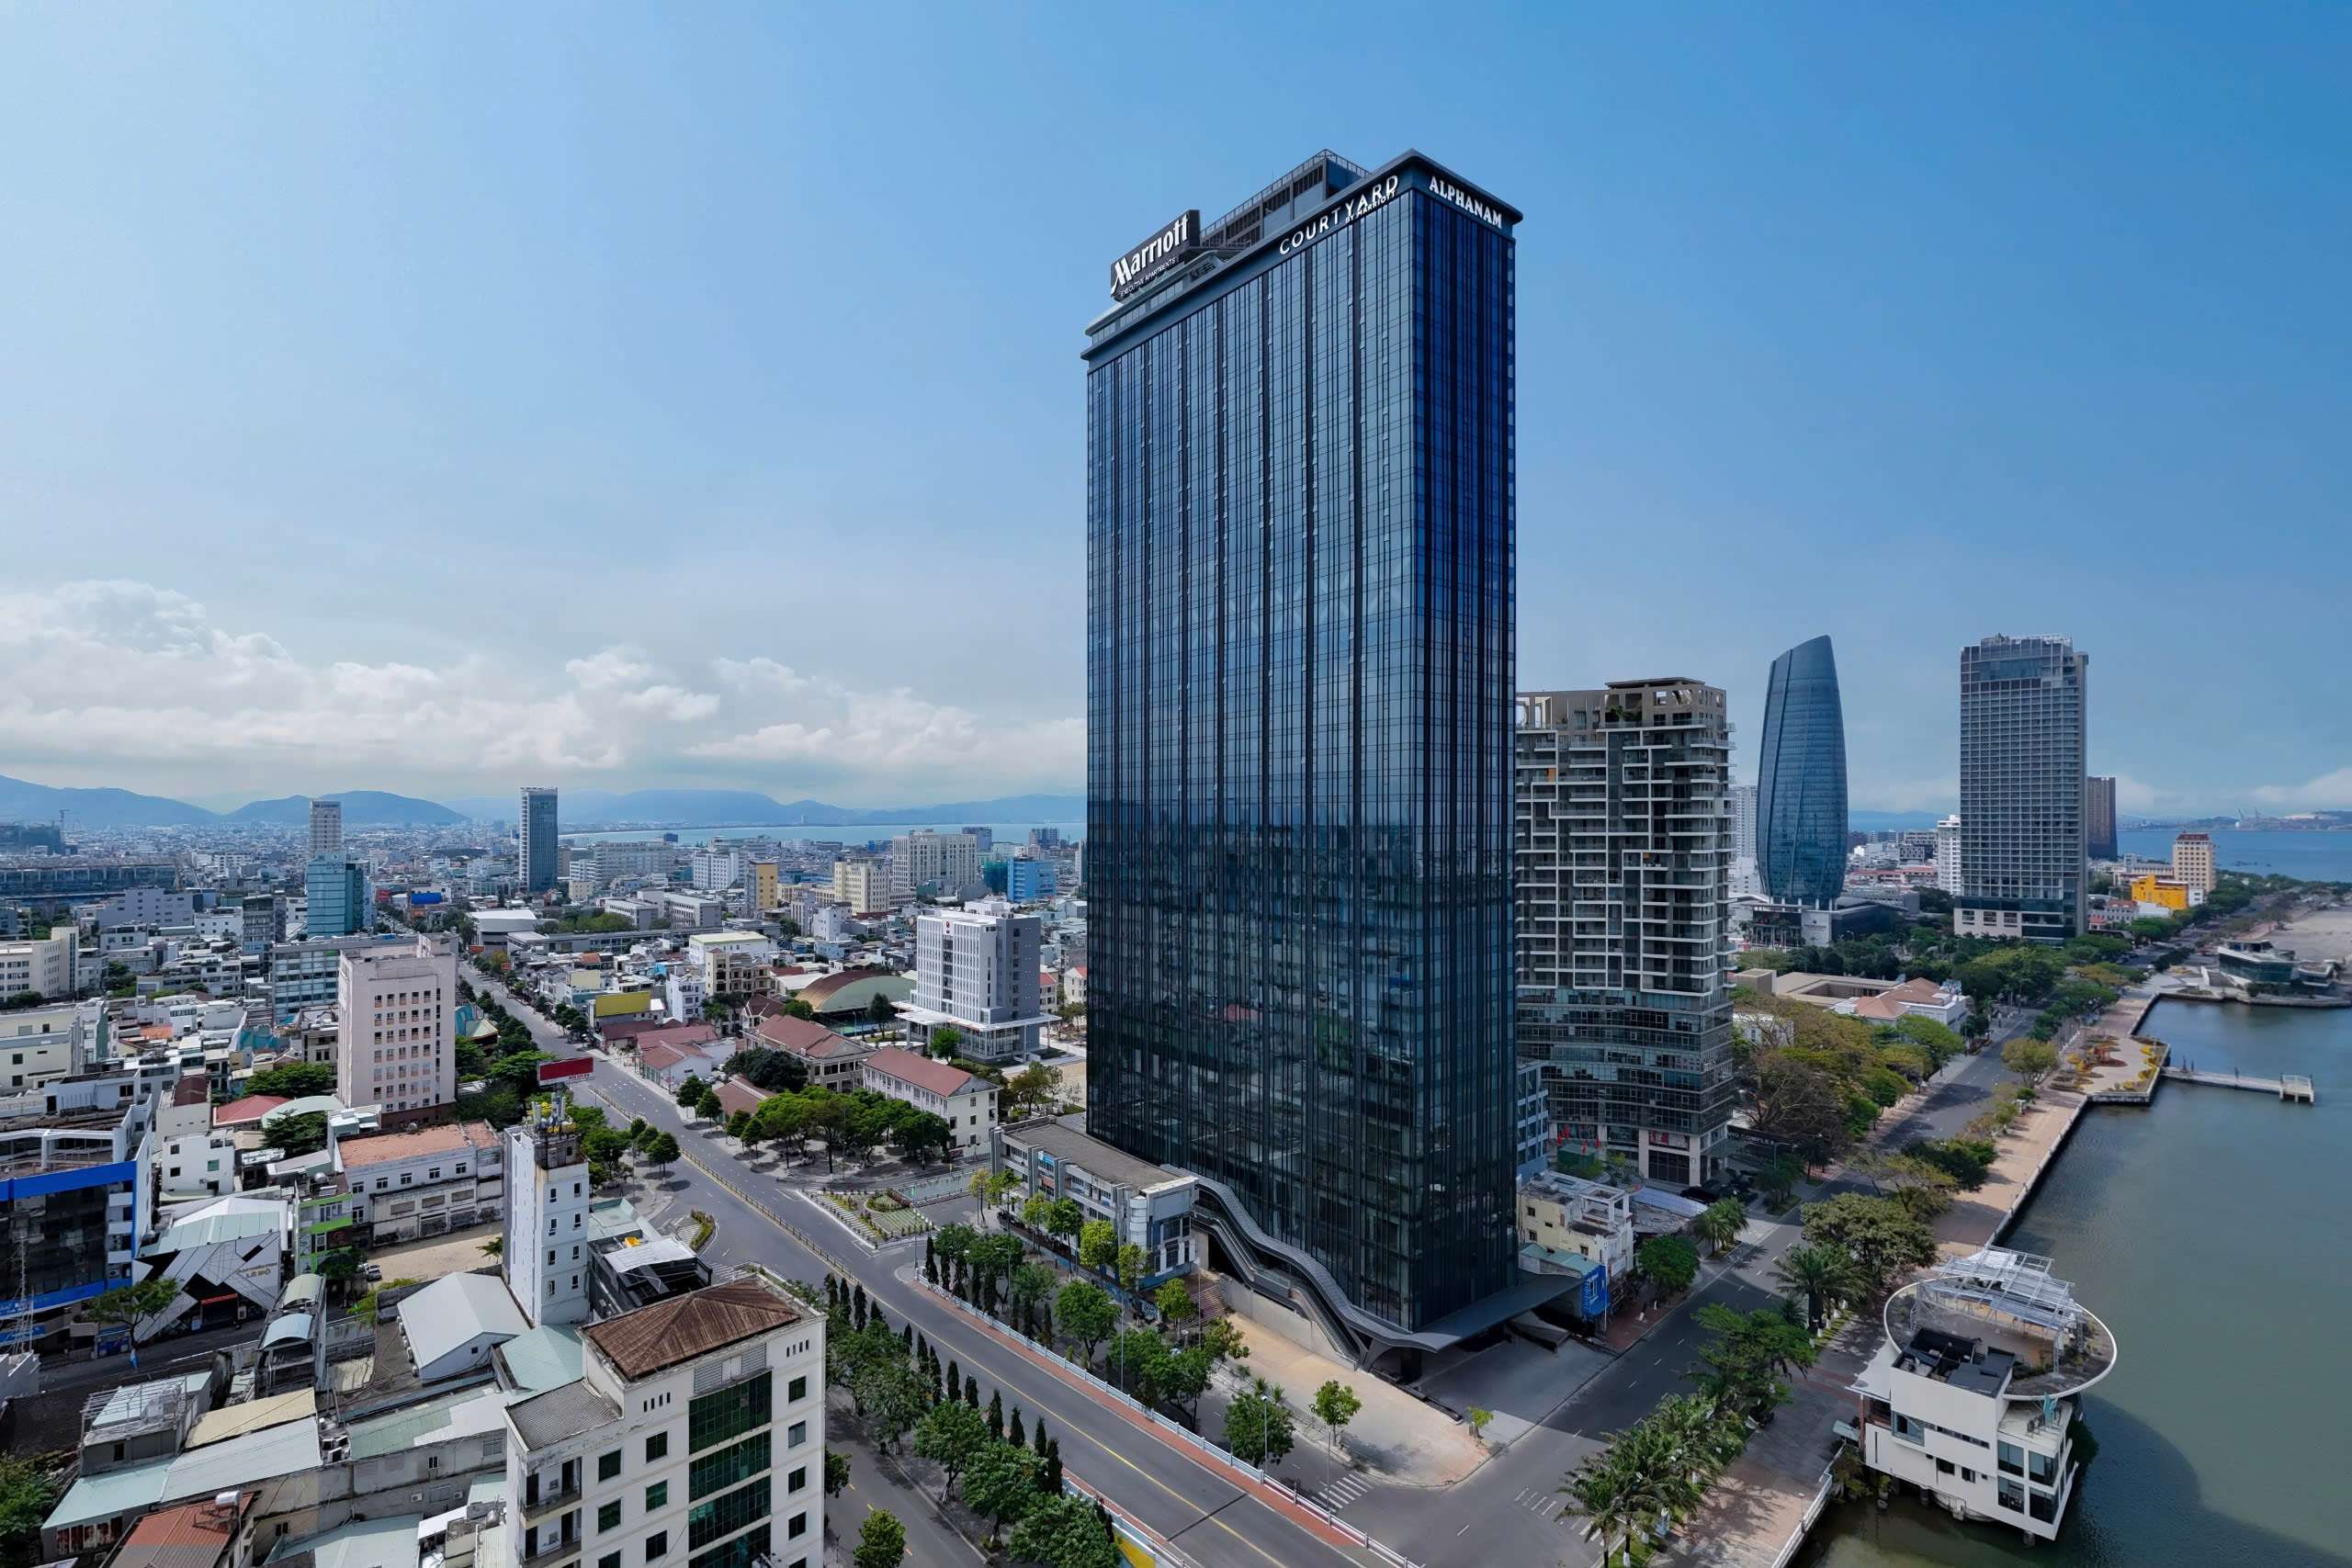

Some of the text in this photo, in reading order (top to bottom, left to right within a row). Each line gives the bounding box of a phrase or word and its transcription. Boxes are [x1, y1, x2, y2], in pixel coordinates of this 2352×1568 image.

[1279, 175, 1398, 255] COURTYARD
[1429, 175, 1502, 229] ALPHANAM
[1110, 213, 1188, 295] Marriott
